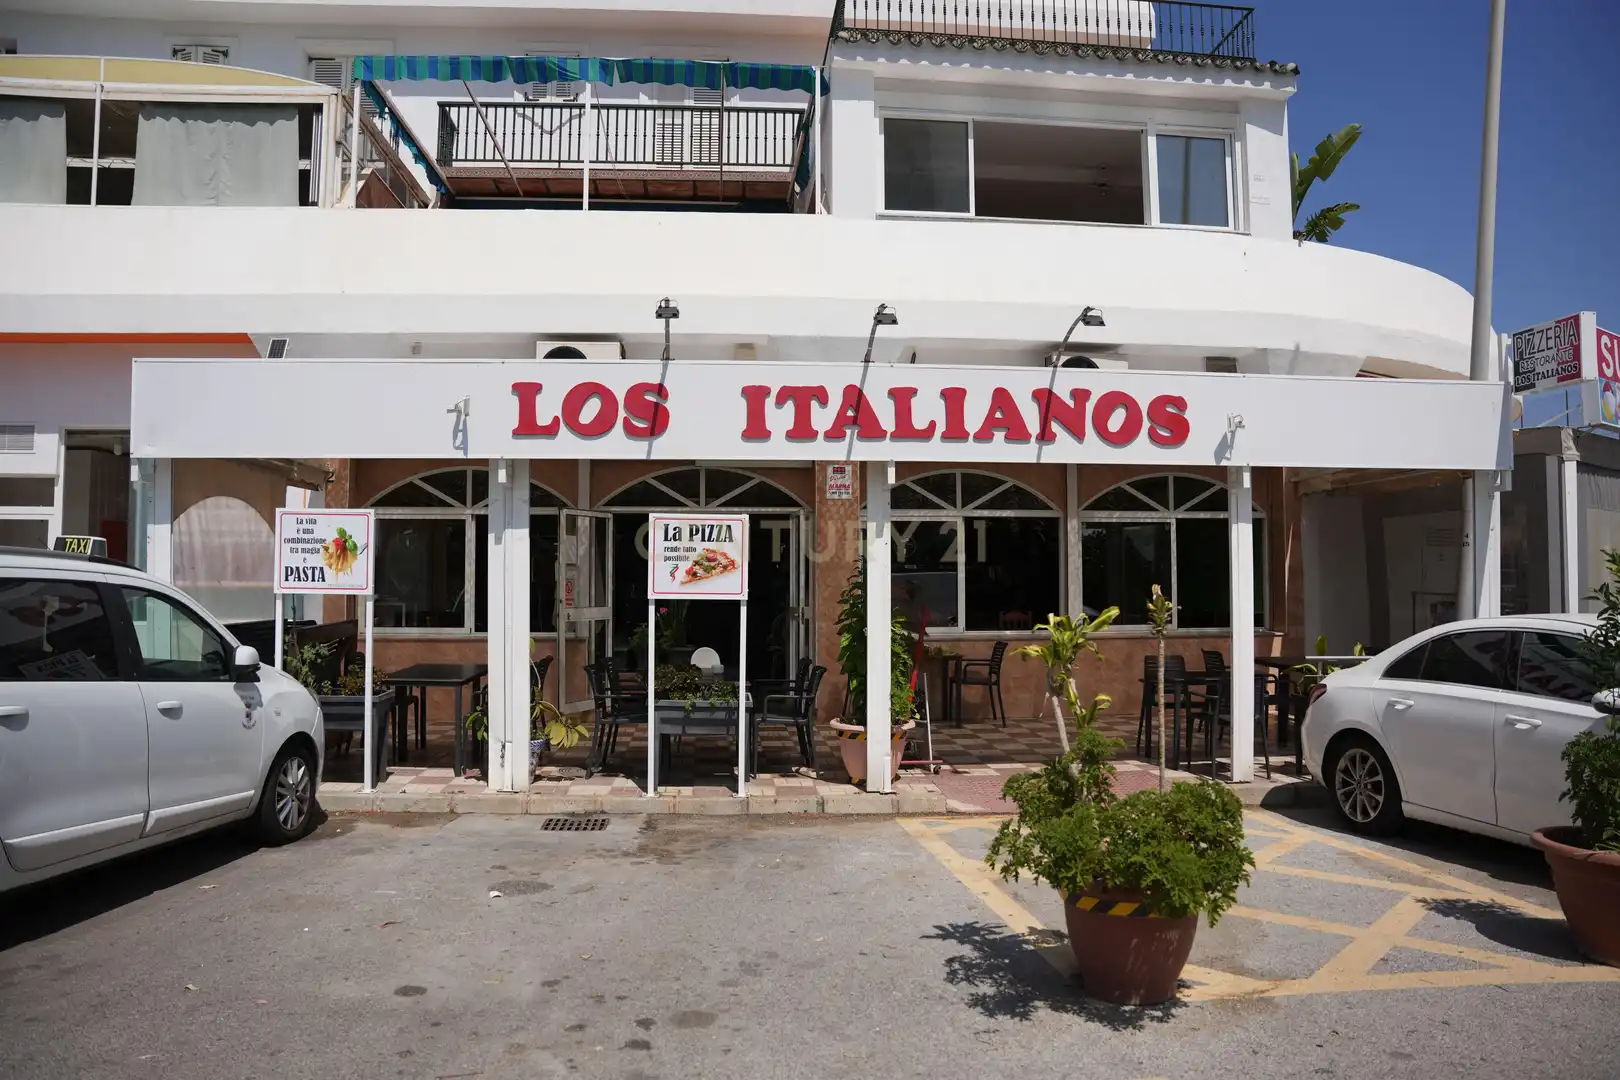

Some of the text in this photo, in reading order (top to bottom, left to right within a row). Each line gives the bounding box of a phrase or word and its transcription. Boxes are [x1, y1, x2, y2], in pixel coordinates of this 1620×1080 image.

[1515, 319, 1578, 360] PIZZERIA
[1520, 347, 1573, 371] RISTORANTE
[1515, 362, 1578, 386] LOS ITALIANOS
[511, 381, 1190, 447] LOS ITALIANOS
[296, 516, 317, 525] La vita
[283, 536, 327, 545] combinazione
[663, 523, 734, 543] La PIZZA
[65, 538, 91, 553] TAXI
[289, 546, 320, 555] tra magia
[663, 545, 697, 553] rende tutto
[663, 554, 690, 563] possibile
[283, 565, 326, 583] PASTA
